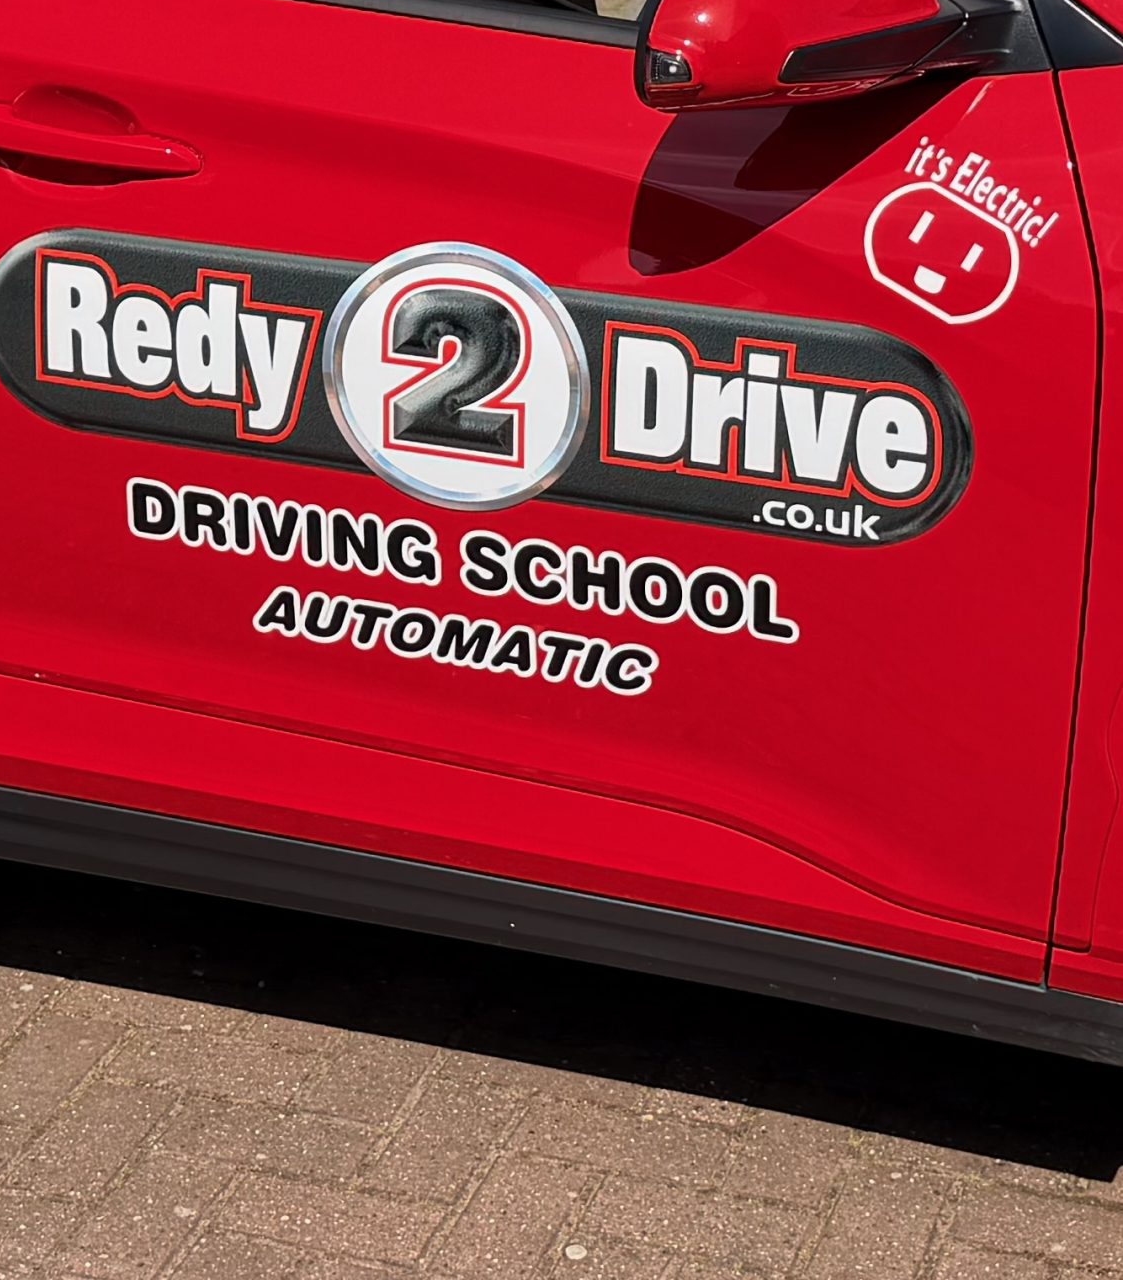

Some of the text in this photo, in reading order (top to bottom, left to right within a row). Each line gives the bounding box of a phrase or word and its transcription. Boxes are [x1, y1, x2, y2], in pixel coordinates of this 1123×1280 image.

[904, 136, 1060, 248] it's Electric!
[42, 256, 932, 498] Redy 2 Drive
[125, 477, 800, 643] DRIVING SCHOOL
[750, 497, 882, 542] .co.uk
[254, 586, 659, 695] AUTOMATIC
